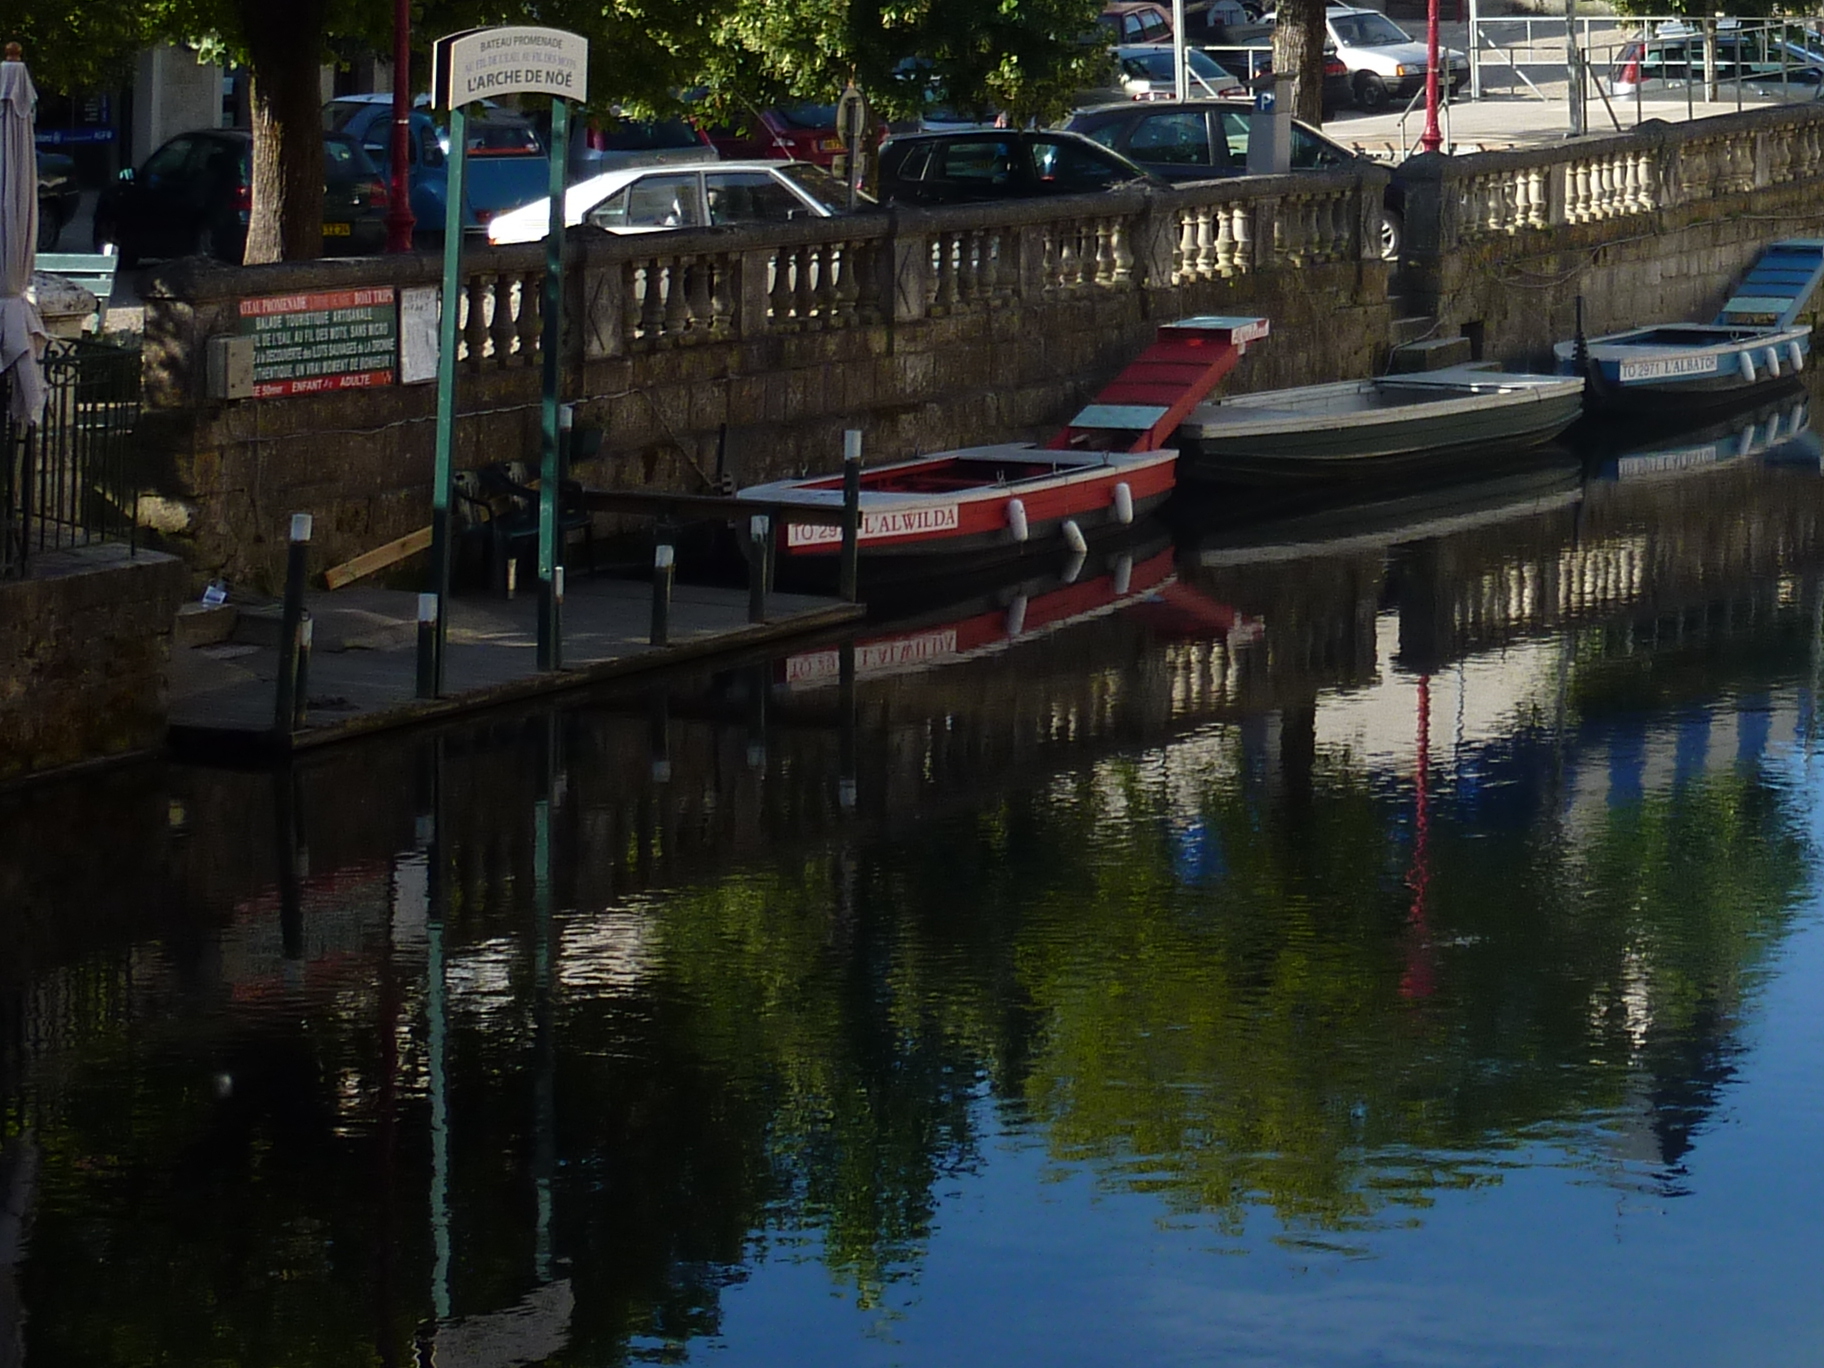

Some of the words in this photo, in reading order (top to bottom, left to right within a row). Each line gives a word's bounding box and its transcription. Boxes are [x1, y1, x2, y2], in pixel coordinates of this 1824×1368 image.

[480, 37, 512, 52] BATEAU
[513, 35, 563, 50] PROMENADE
[475, 59, 487, 70] FIL
[488, 56, 498, 66] DE
[532, 52, 543, 62] FIL
[544, 53, 557, 64] DES
[558, 56, 578, 70] MOTS
[467, 70, 522, 93] L'ARCHE
[525, 69, 543, 83] DE
[262, 296, 308, 313] PROMENADE
[354, 290, 372, 306] BOAT
[373, 288, 394, 304] TRIPS
[255, 314, 283, 331] BALADE
[286, 310, 329, 328] TOURISTIQUE
[332, 307, 373, 323] ARTISANALE
[316, 328, 329, 342] DES
[350, 325, 367, 338] SANS
[368, 322, 388, 337] MICRO
[1622, 364, 1636, 378] TO
[291, 379, 323, 393] ENFANT
[339, 375, 371, 387] ADULTE
[793, 523, 814, 541] TO
[864, 508, 956, 535] L'ALWILDA
